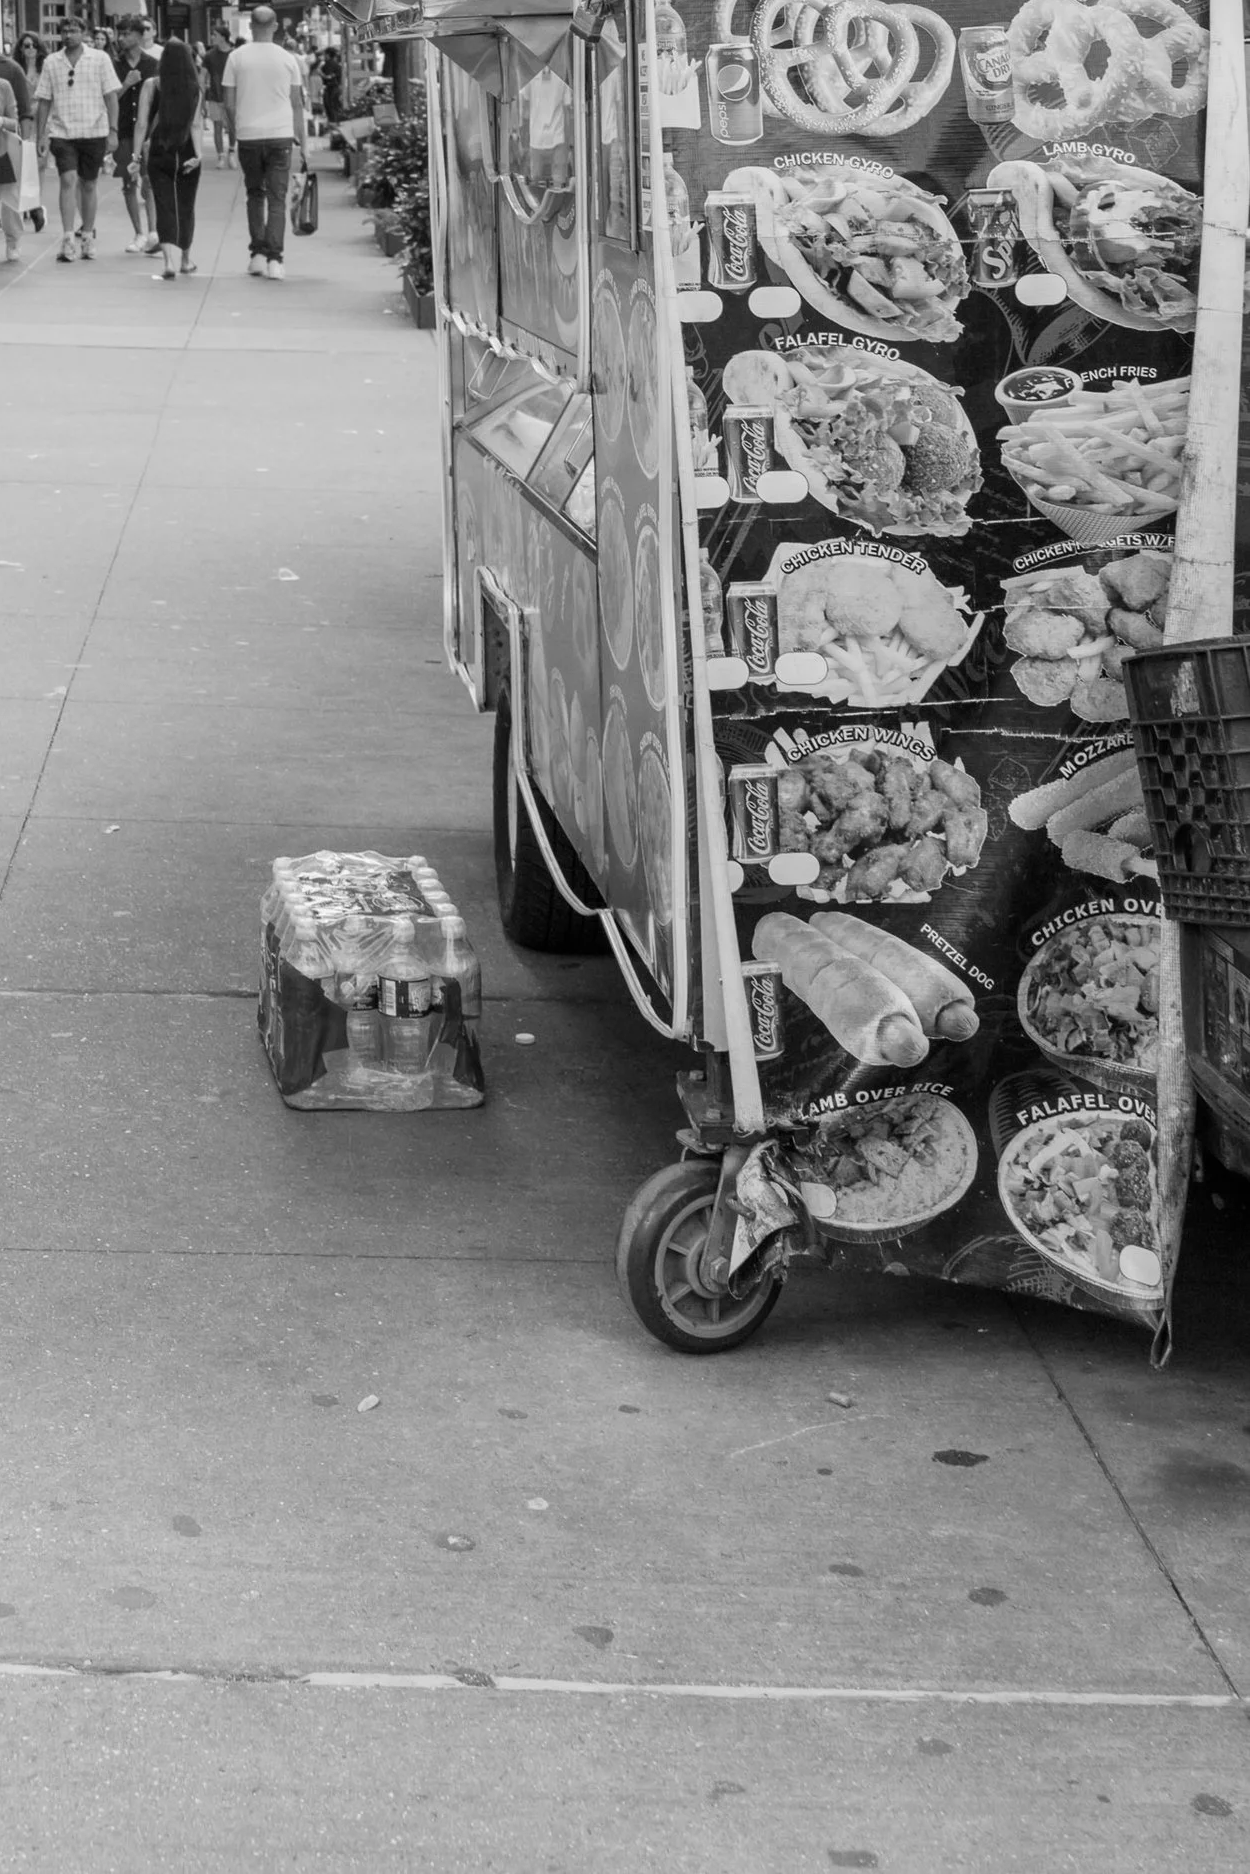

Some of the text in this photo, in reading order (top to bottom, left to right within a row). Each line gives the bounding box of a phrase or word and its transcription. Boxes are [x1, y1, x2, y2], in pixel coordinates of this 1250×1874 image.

[716, 101, 731, 139] pepsi
[774, 152, 894, 180] CHICKEN GYRO
[1042, 141, 1137, 164] LAMB GYRO
[774, 332, 900, 361] FALAFEL GYRO
[1064, 366, 1158, 389] FENCH FRIES
[780, 541, 926, 574] CHICKEN TENDER
[1015, 541, 1074, 570] CHICKEN
[787, 728, 936, 763] CHICKEN WINGS
[1031, 898, 1116, 948] CHICKEN
[919, 923, 995, 991] PRETZEL DOG
[855, 1084, 905, 1104] OVER
[912, 1082, 955, 1097] RICE
[1015, 1093, 1110, 1126] FALAFEL
